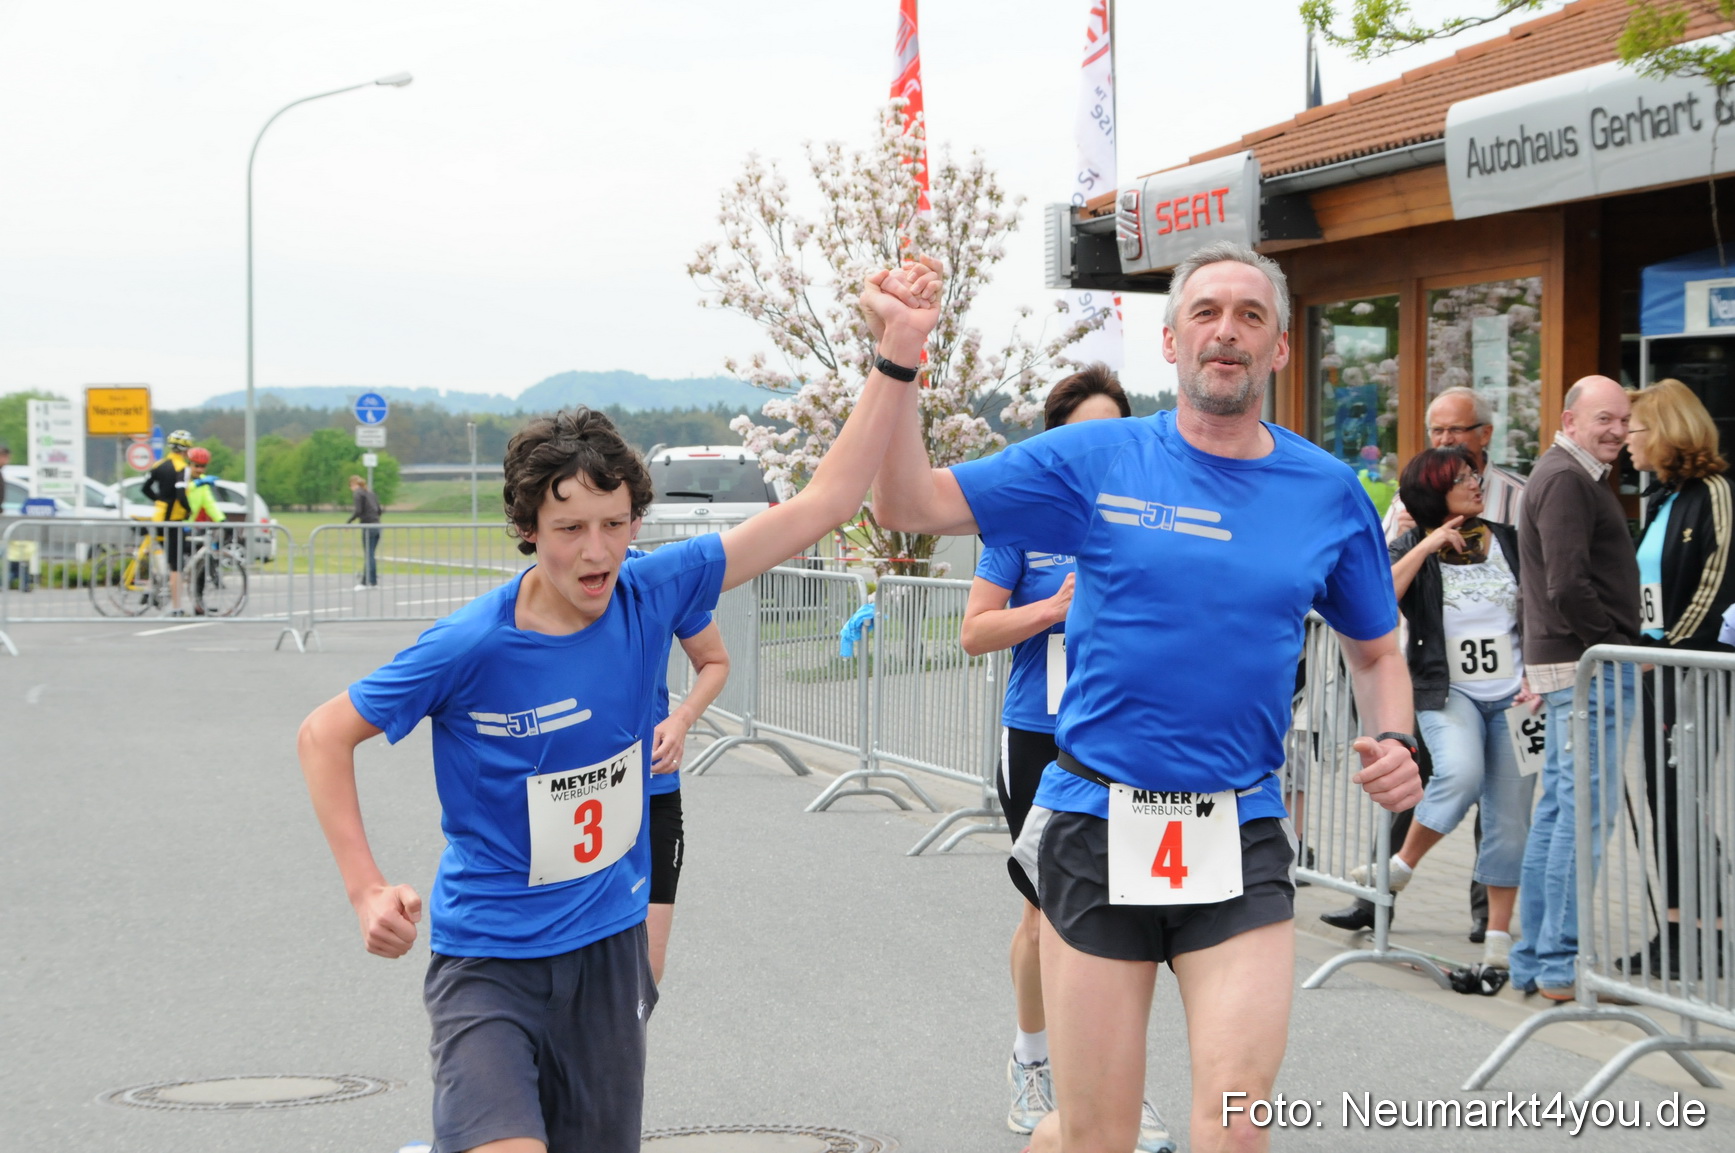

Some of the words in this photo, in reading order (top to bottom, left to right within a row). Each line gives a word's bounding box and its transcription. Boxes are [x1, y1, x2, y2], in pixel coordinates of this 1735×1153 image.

[1467, 124, 1579, 178] Autohaus
[1591, 92, 1703, 151] Gerhart
[1156, 187, 1230, 235] SEAT
[1461, 639, 1498, 675] 35
[1521, 713, 1547, 755] 34
[551, 767, 608, 792] MEYER
[551, 780, 608, 802] WERBUNG
[1132, 790, 1192, 804] MEYER
[1132, 804, 1193, 816] WERBUNG
[573, 799, 603, 864] 3
[1151, 820, 1188, 889] 4
